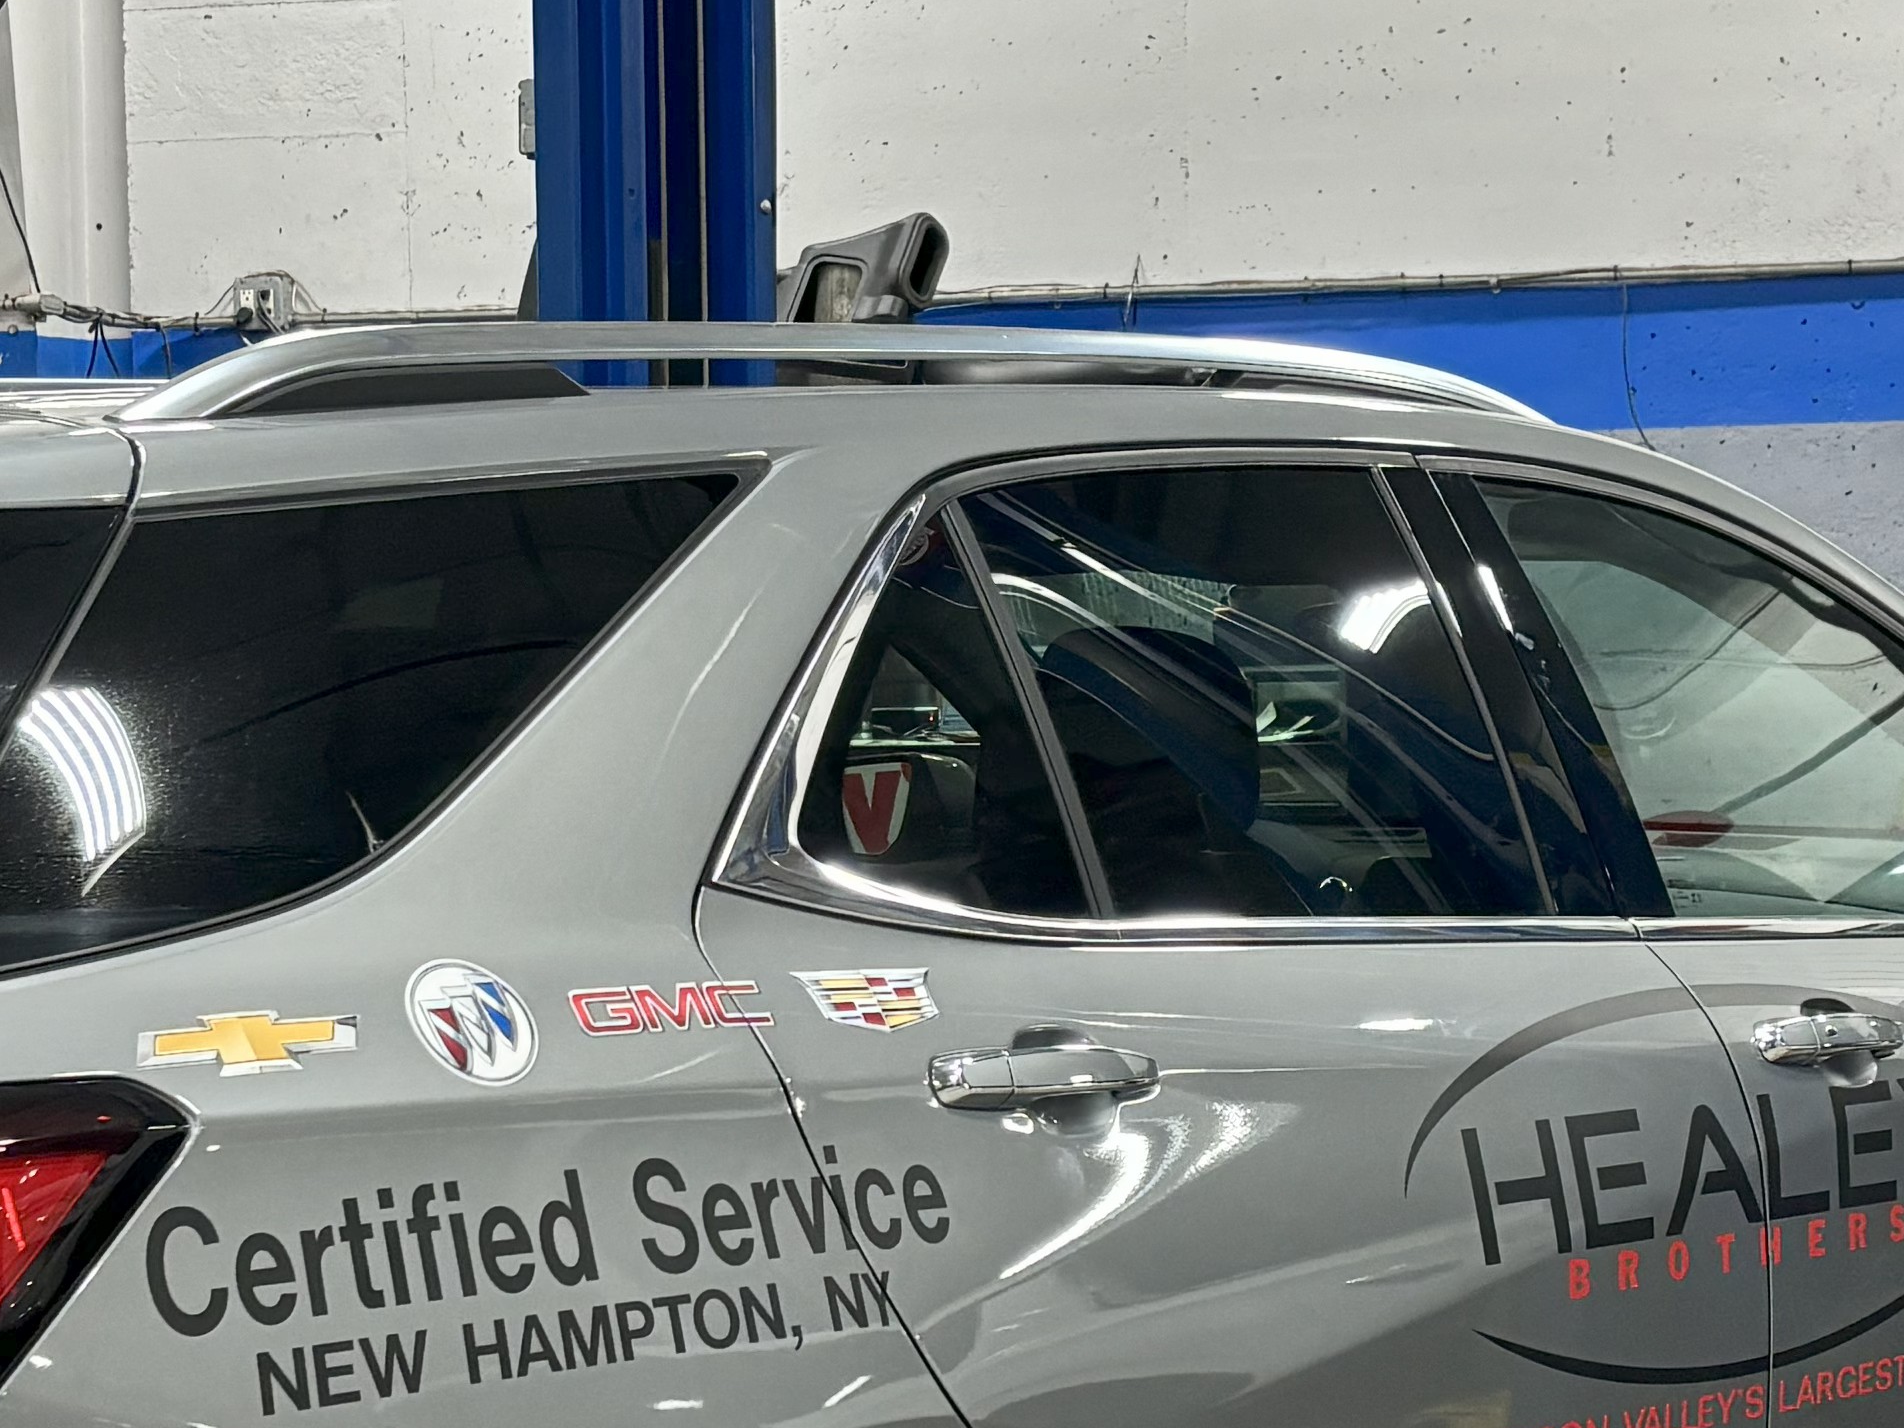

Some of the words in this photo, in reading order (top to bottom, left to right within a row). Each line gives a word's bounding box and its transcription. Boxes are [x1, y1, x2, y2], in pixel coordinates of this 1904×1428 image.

[568, 980, 775, 1038] GMC
[145, 1169, 600, 1338] Certified
[632, 1145, 952, 1277] Service
[255, 1329, 427, 1417] NEW
[463, 1283, 803, 1386] HAMPTON,
[824, 1269, 892, 1334] NY
